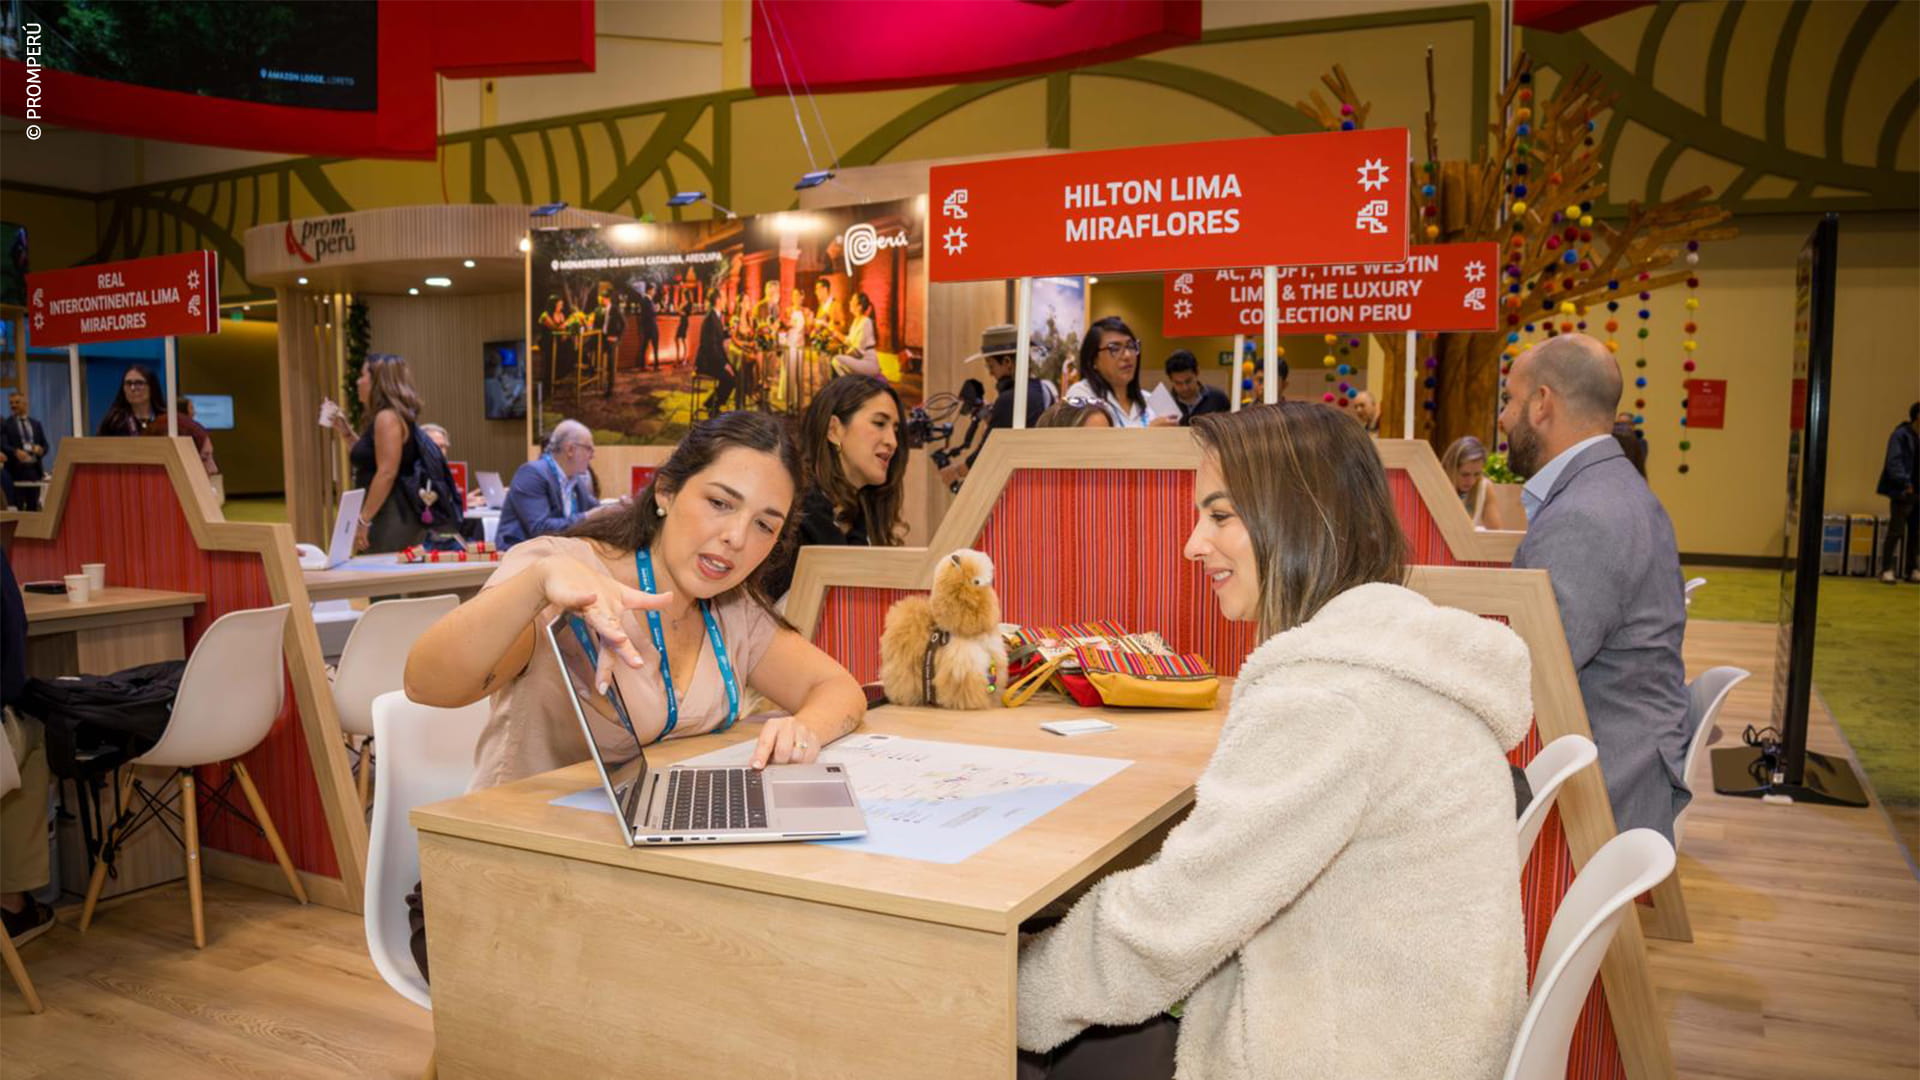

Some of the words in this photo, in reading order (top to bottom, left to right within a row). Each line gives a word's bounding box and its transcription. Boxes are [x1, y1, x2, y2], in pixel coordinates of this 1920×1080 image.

[1064, 179, 1162, 209] HILTON
[1171, 173, 1242, 201] LIMA
[302, 217, 346, 245] prom
[1065, 208, 1240, 242] MIRAFLORES
[315, 228, 355, 262] perú
[560, 259, 608, 270] MONASTERIO
[609, 258, 620, 268] DE
[621, 256, 646, 267] SANTA
[686, 251, 722, 264] AREQUIPA
[97, 272, 125, 289] REAL
[1249, 266, 1315, 280] AOFT,
[50, 291, 149, 316] INTERCONTINENTAL
[151, 287, 181, 305] LIMA
[1230, 285, 1265, 303] LIM
[1282, 284, 1296, 301] &
[1300, 281, 1338, 300] THE
[1342, 279, 1423, 299] LUXURY
[80, 312, 147, 333] MIRAFLORES
[1239, 305, 1355, 325] COLECTION
[1359, 303, 1412, 322] PERU
